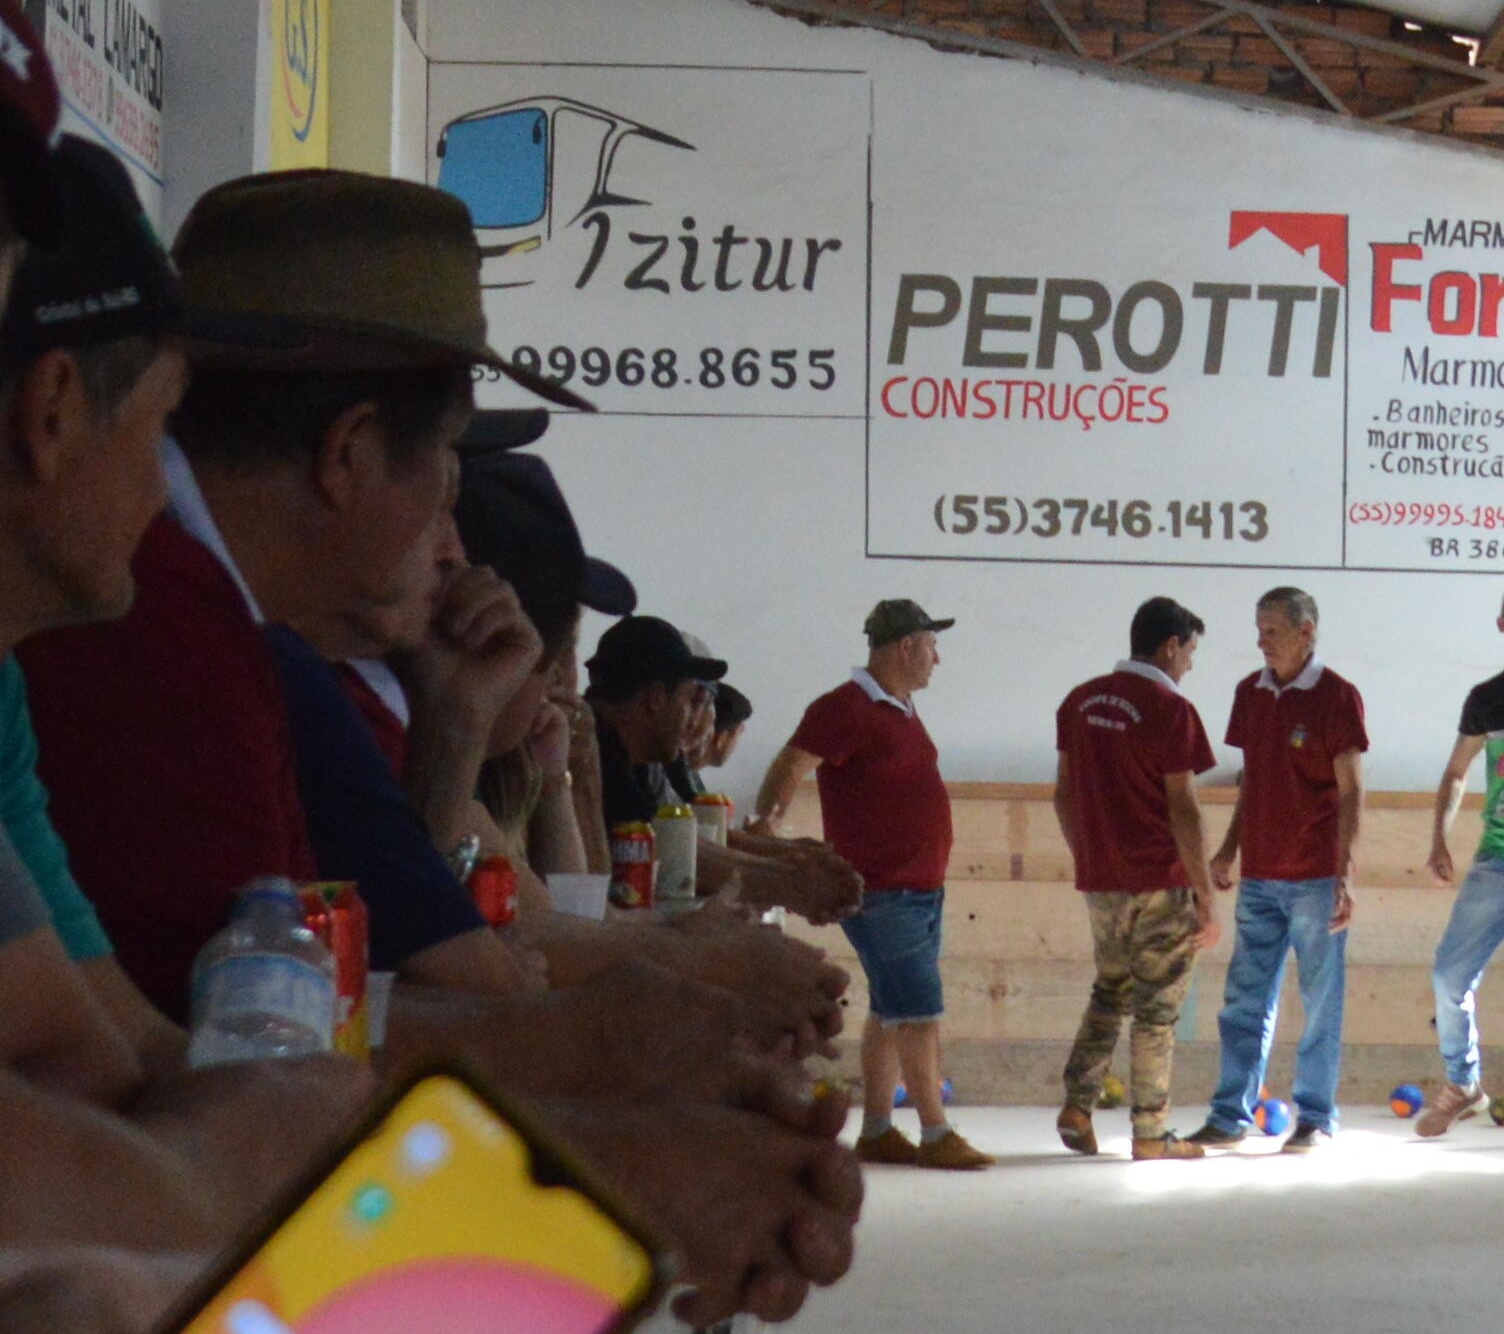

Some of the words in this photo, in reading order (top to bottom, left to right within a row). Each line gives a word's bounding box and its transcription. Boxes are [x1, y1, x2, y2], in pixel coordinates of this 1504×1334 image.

[886, 272, 1341, 379] PEROTTI
[880, 375, 1170, 431] CONSTRUÇÕES
[1367, 428, 1490, 454] marmores
[933, 493, 1269, 542] (55)3746.1413
[1429, 537, 1460, 558] BR
